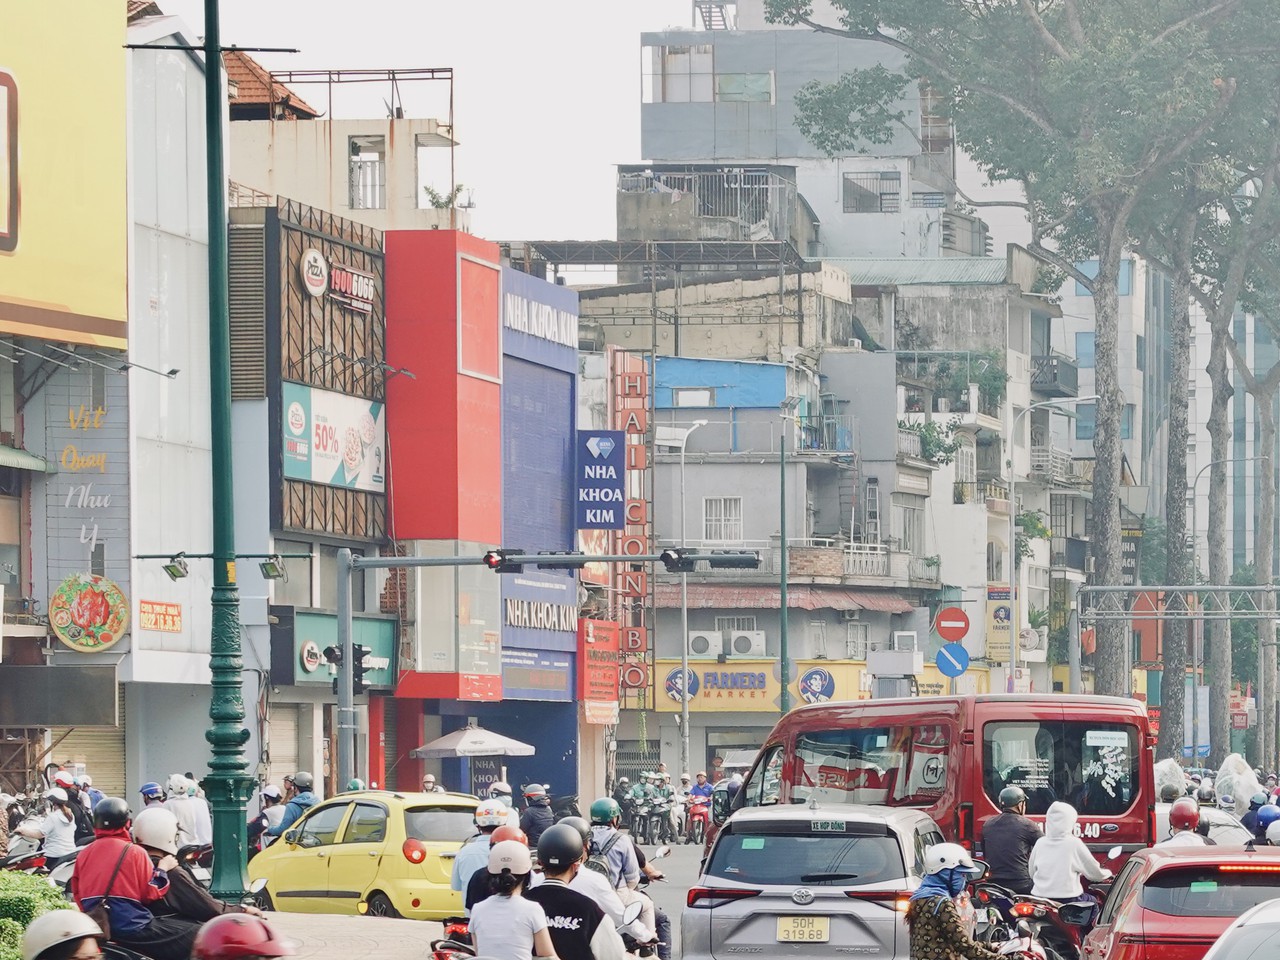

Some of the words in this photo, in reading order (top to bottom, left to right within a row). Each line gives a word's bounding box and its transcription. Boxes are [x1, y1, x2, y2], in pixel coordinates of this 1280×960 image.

[315, 423, 339, 454] 50%
[61, 444, 107, 474] Quay
[584, 465, 617, 480] NHA
[578, 488, 624, 502] KHOA
[585, 509, 615, 523] KIM
[505, 598, 530, 628] NHA
[530, 600, 559, 631] KHOA
[703, 671, 766, 690] FARMERS
[704, 690, 768, 699] MARKET
[475, 760, 496, 769] NHA
[812, 821, 819, 830] XE
[792, 918, 815, 929] 50H
[783, 929, 823, 940] 319.68
